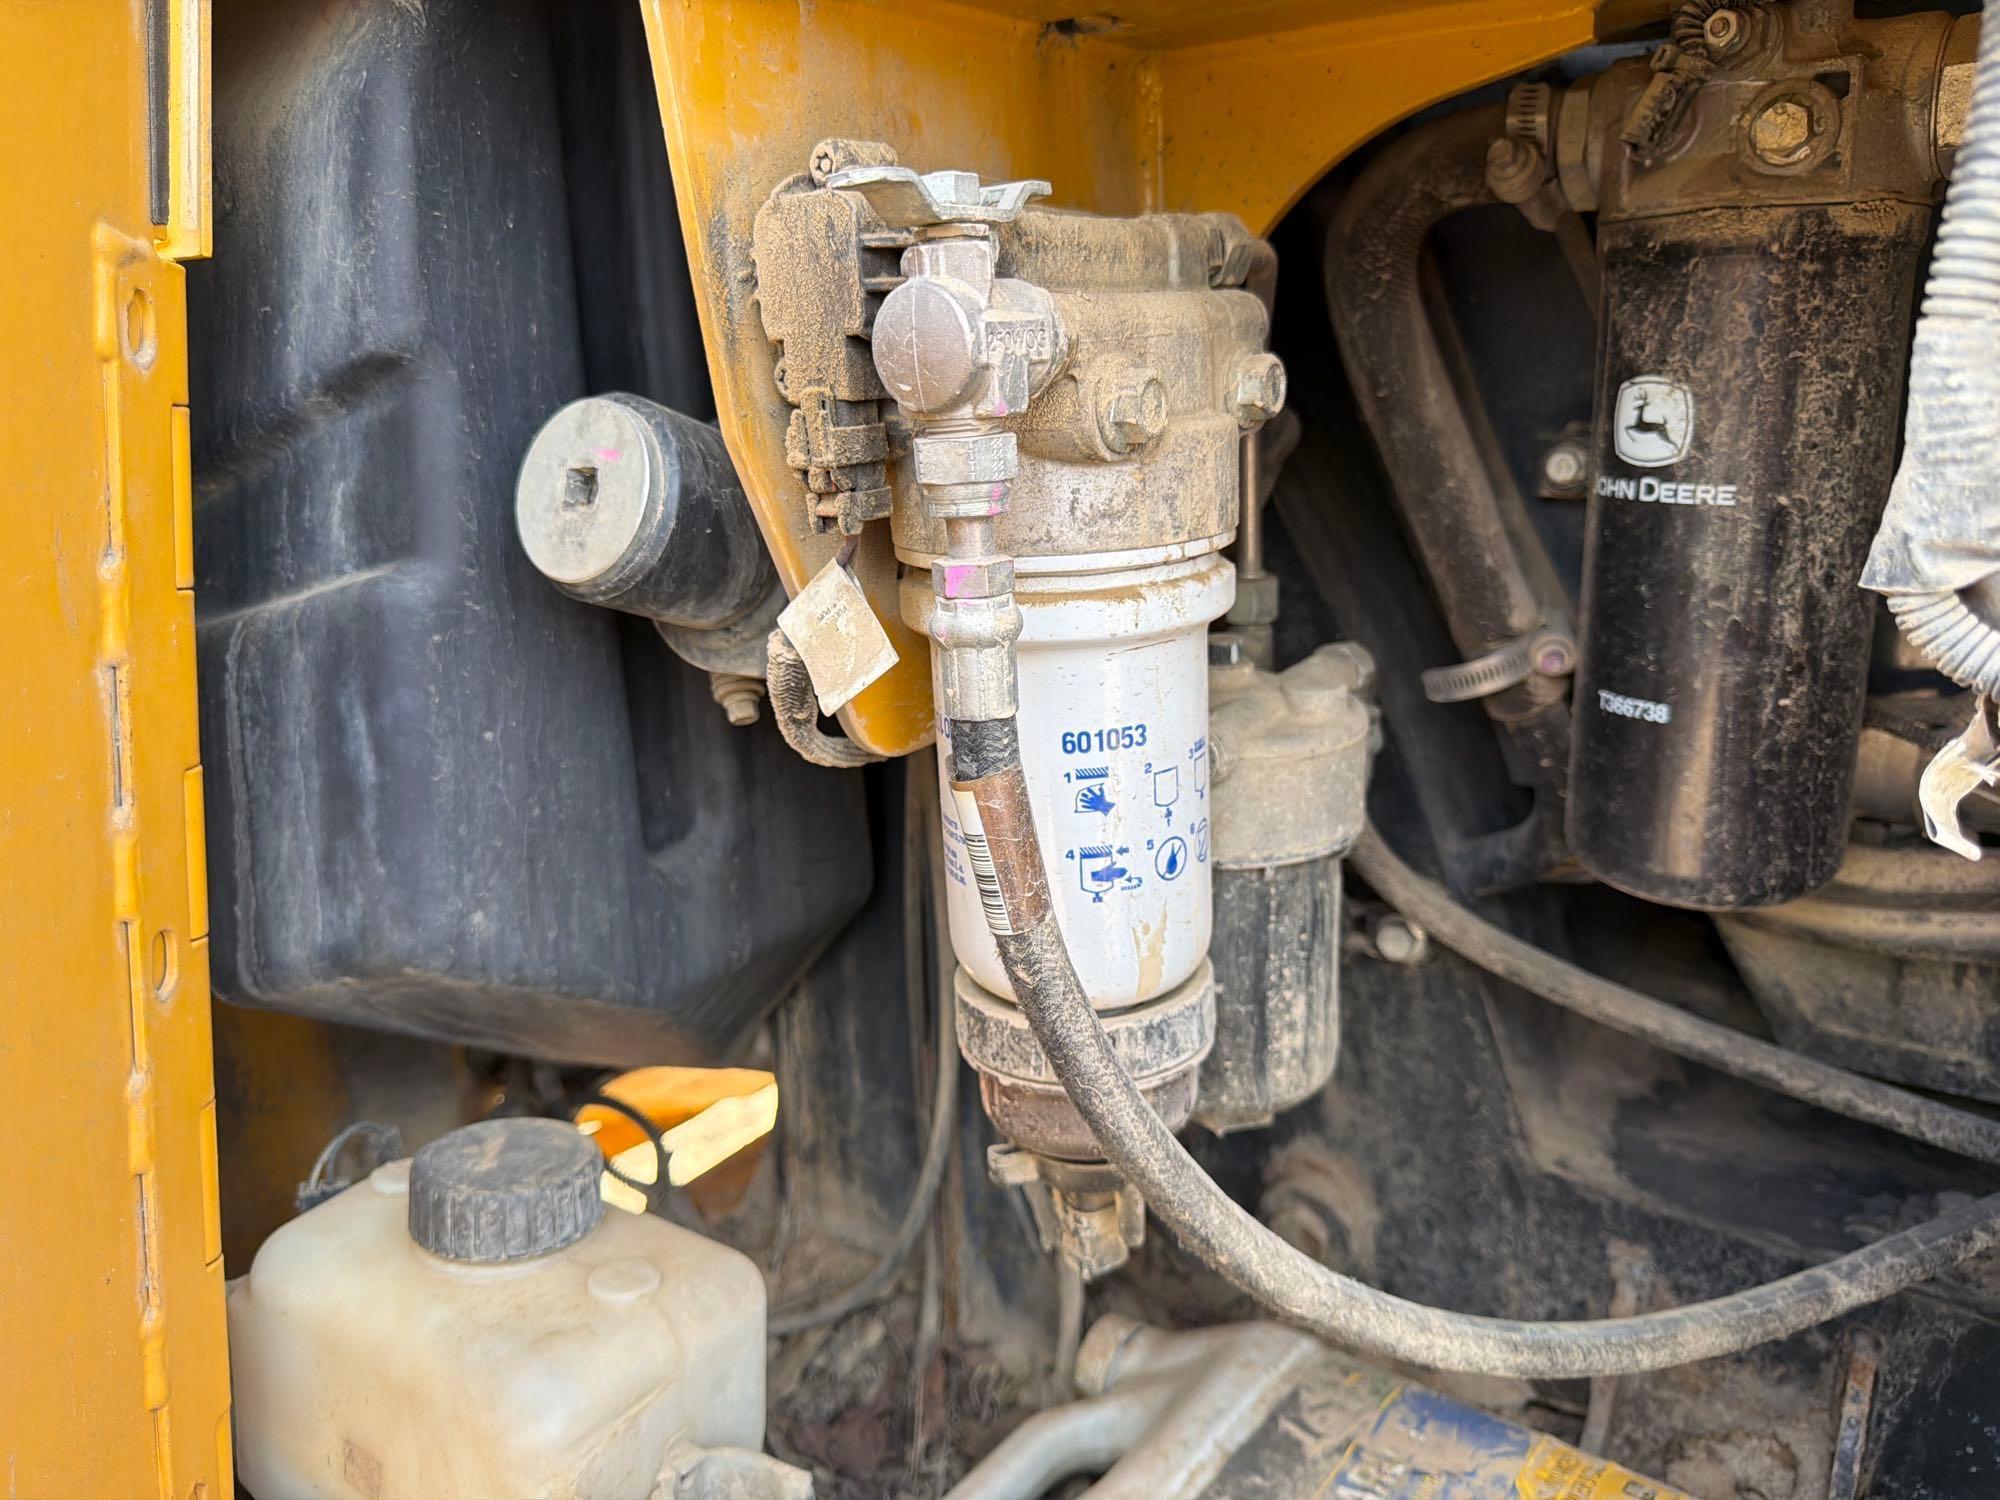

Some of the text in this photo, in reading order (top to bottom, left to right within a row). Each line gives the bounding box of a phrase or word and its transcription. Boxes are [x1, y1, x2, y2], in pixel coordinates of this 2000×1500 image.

[1639, 475, 1738, 507] DEERE
[1061, 723, 1148, 755] 601053
[1143, 762, 1153, 775] 2
[1063, 771, 1072, 784] 1
[1146, 839, 1155, 851] 5
[1065, 849, 1076, 861] 4
